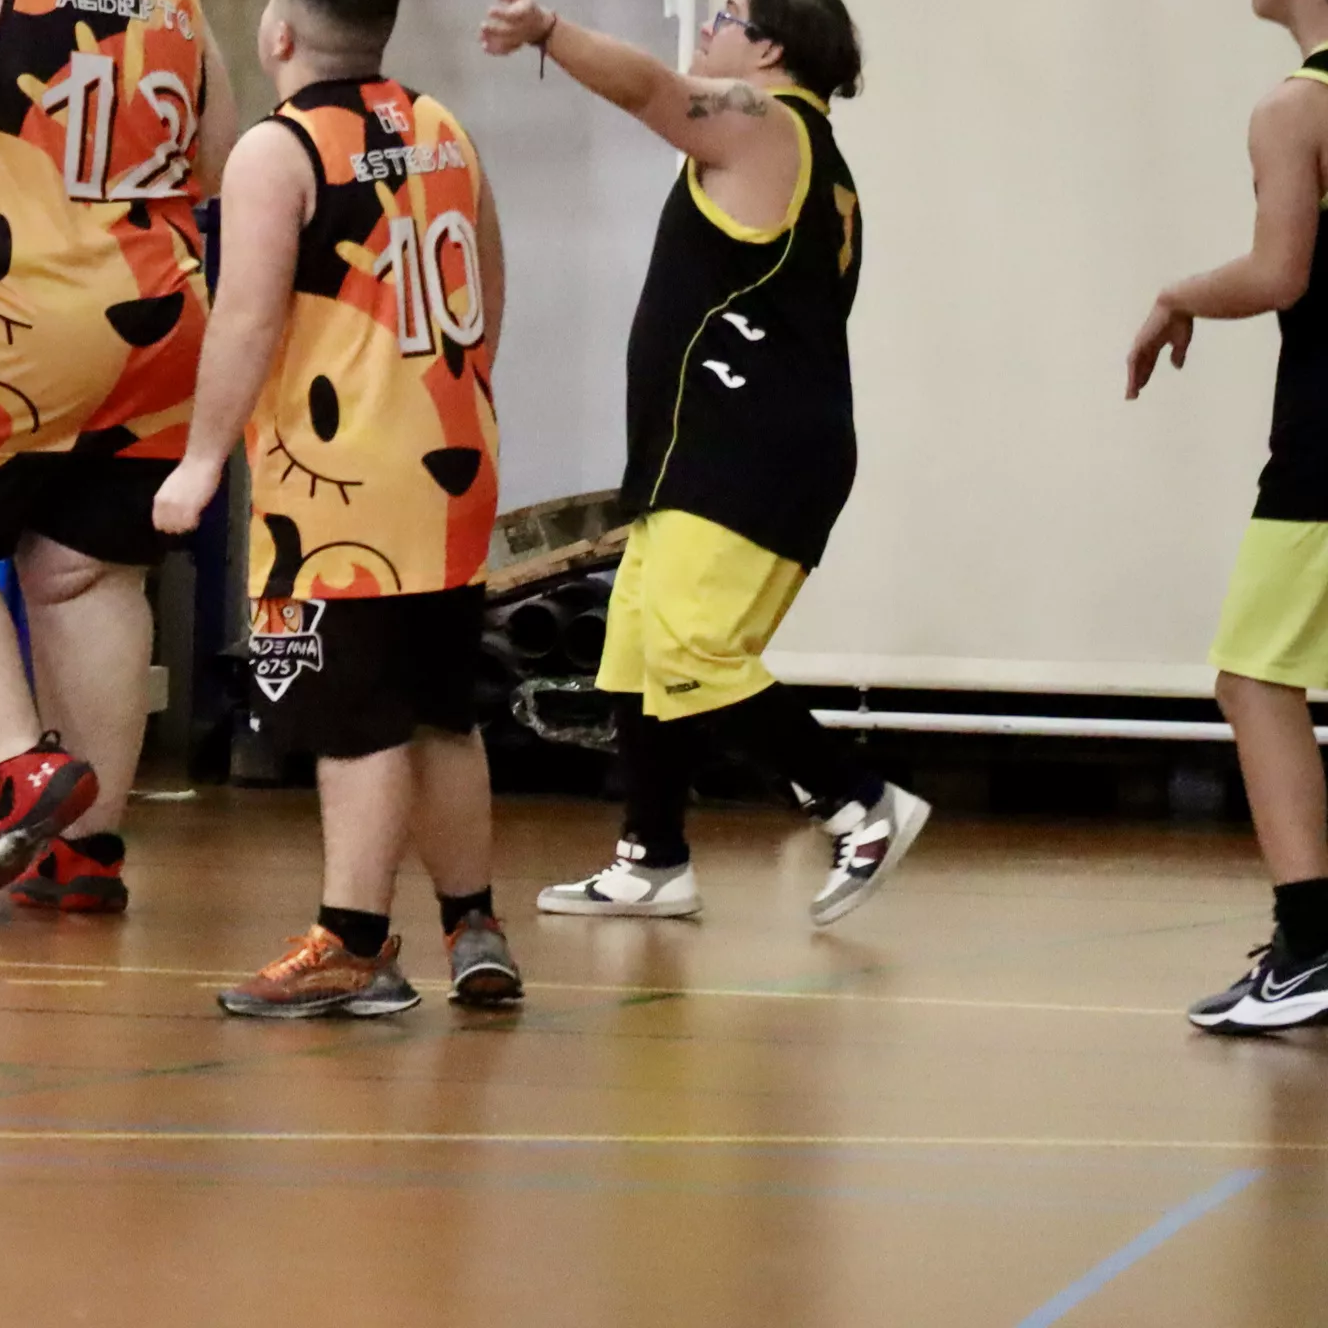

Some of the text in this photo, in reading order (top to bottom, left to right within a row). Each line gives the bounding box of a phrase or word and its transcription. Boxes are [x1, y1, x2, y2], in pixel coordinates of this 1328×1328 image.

[43, 51, 198, 202] 12
[350, 139, 466, 183] ESTEBAN
[373, 211, 484, 356] 10
